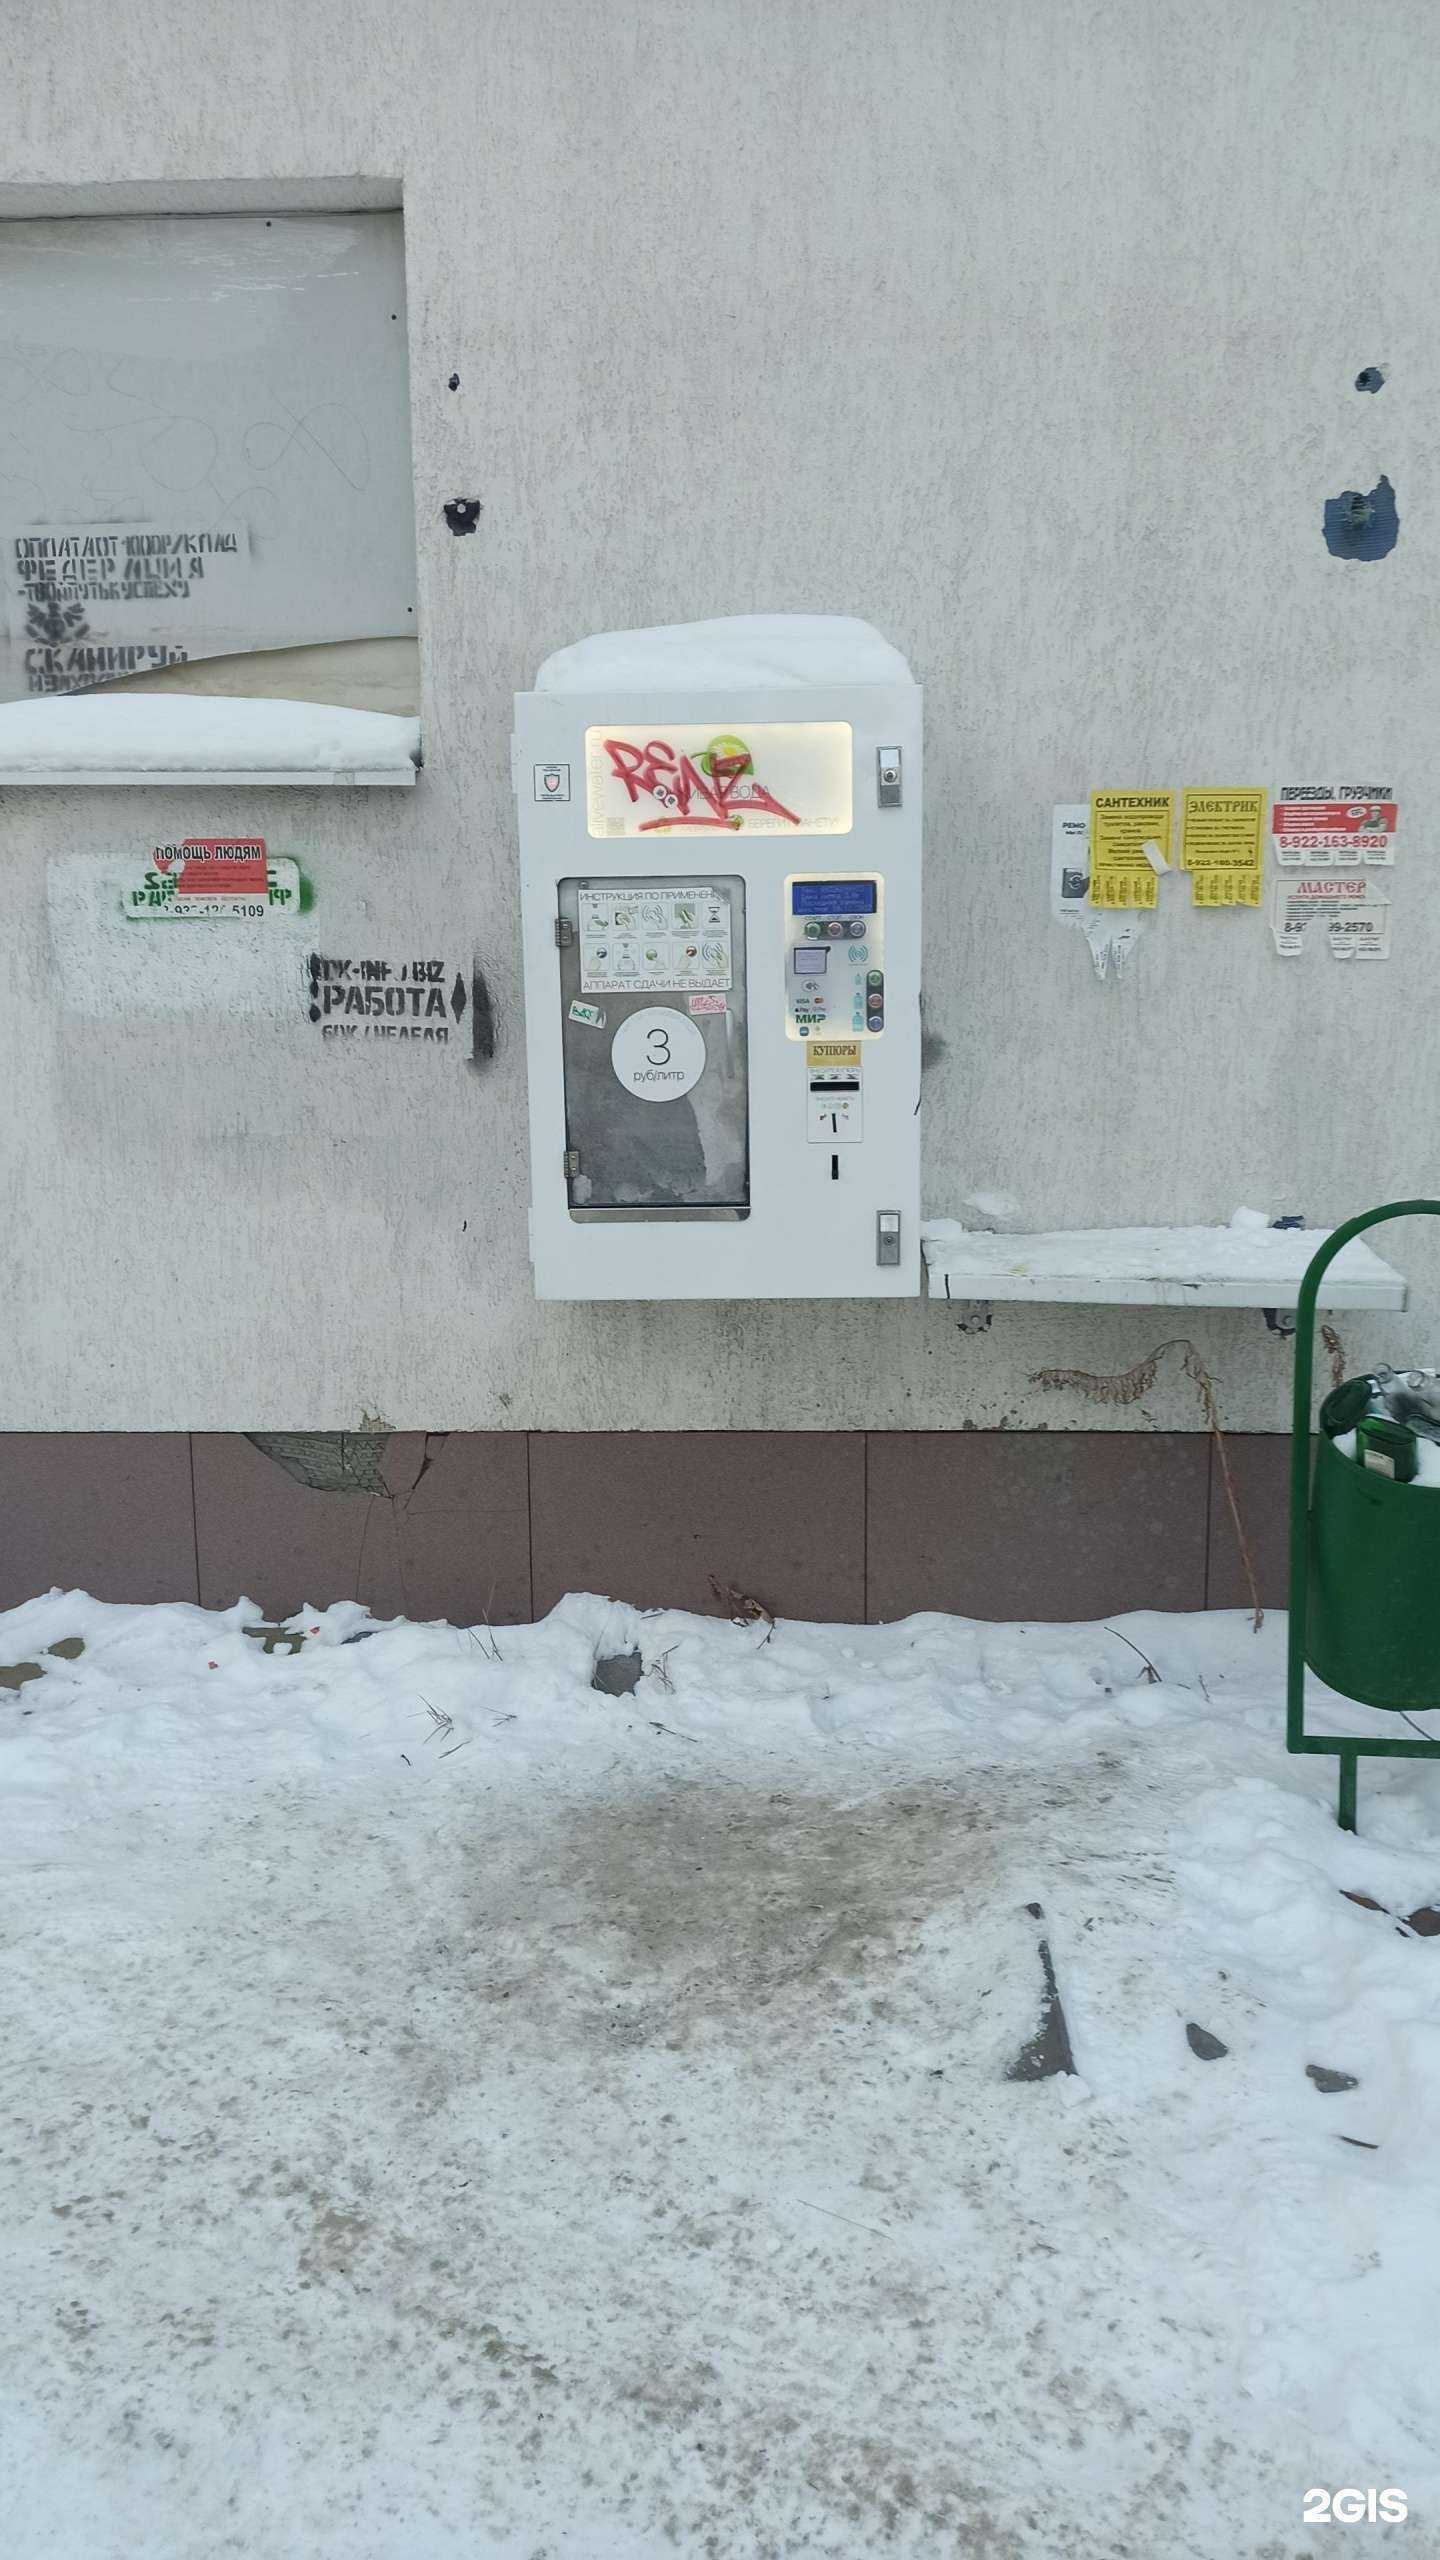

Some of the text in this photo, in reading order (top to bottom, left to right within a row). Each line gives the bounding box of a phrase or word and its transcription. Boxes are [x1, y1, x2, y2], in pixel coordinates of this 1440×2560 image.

[1095, 796, 1170, 808] САНТЕХНИК
[1188, 800, 1259, 813] ЭЛЕКТРИК
[155, 845, 261, 862] ПОМОЩЬ ЛЮДЯМ
[1297, 881, 1367, 894] МАСТЕР
[580, 889, 715, 901] ИНСТРУКЦИЯ ПО ПРИМЕНЕН
[583, 977, 730, 990] АППАРАТ СДАЧИ НЕ ВЫДАЕТ
[323, 985, 447, 1018] РАБОТА
[795, 1014, 826, 1024] МИР
[646, 1028, 671, 1065] 3
[813, 1045, 857, 1056] КУПЮРЫ
[633, 1069, 685, 1083] руб/литр
